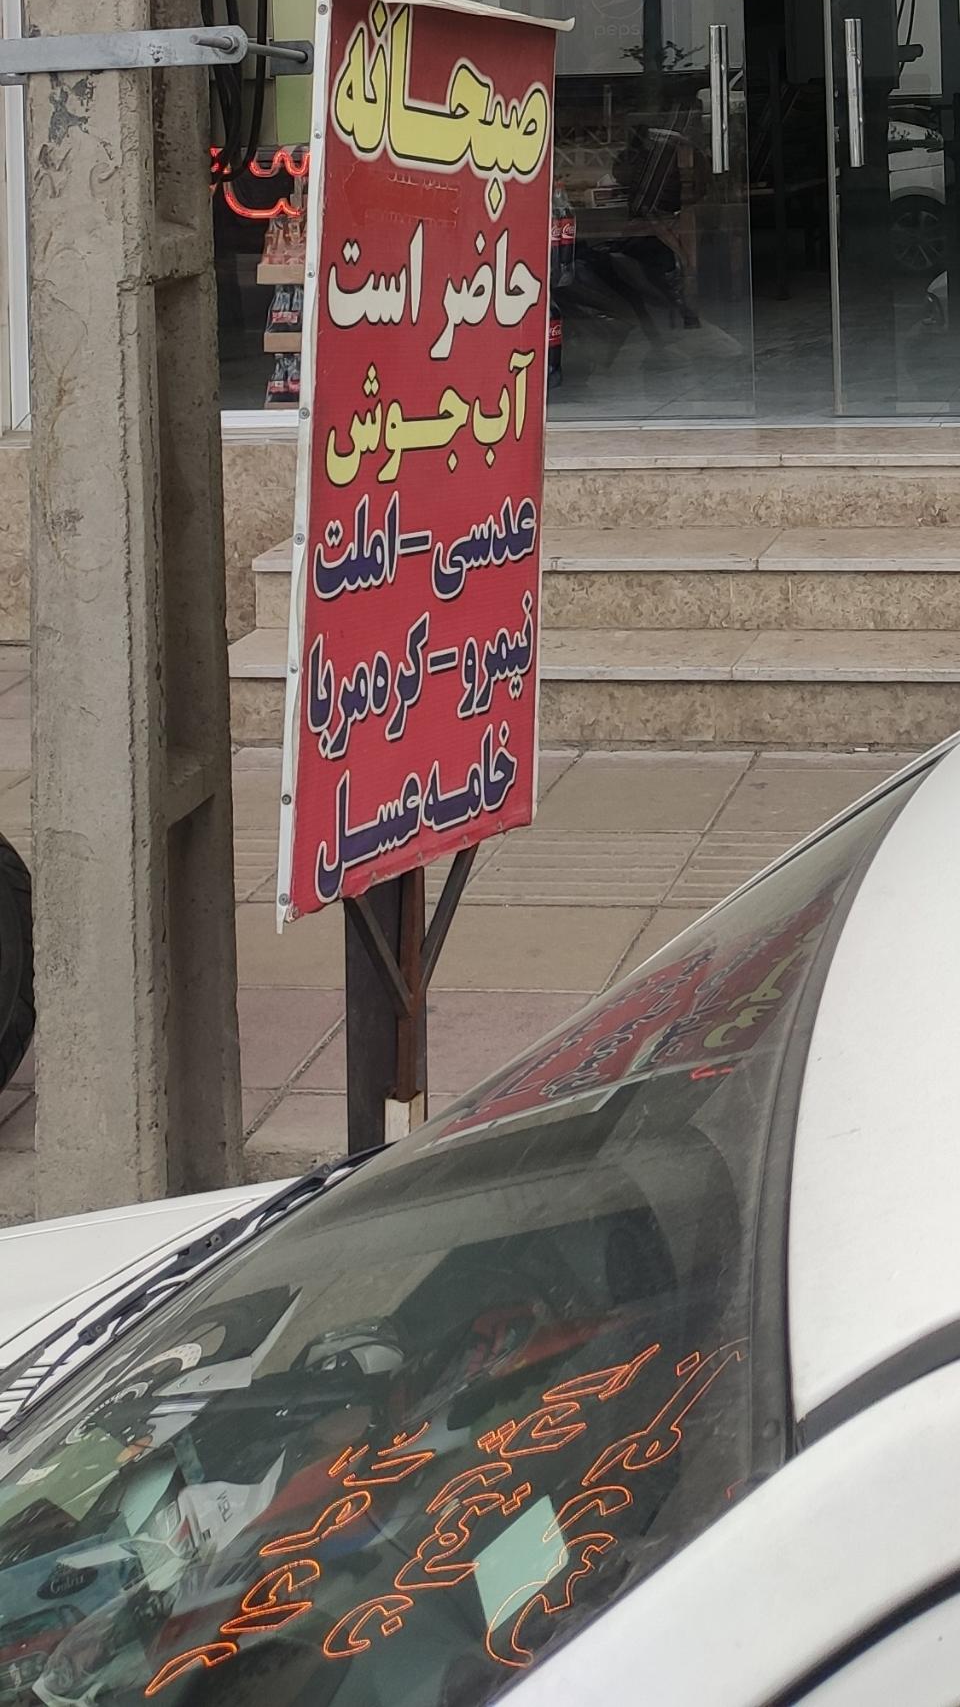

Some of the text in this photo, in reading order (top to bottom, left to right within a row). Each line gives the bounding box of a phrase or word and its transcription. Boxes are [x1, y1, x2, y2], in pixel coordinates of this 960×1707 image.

[333, 0, 551, 219] صبحانه
[328, 220, 542, 360] حاضر است
